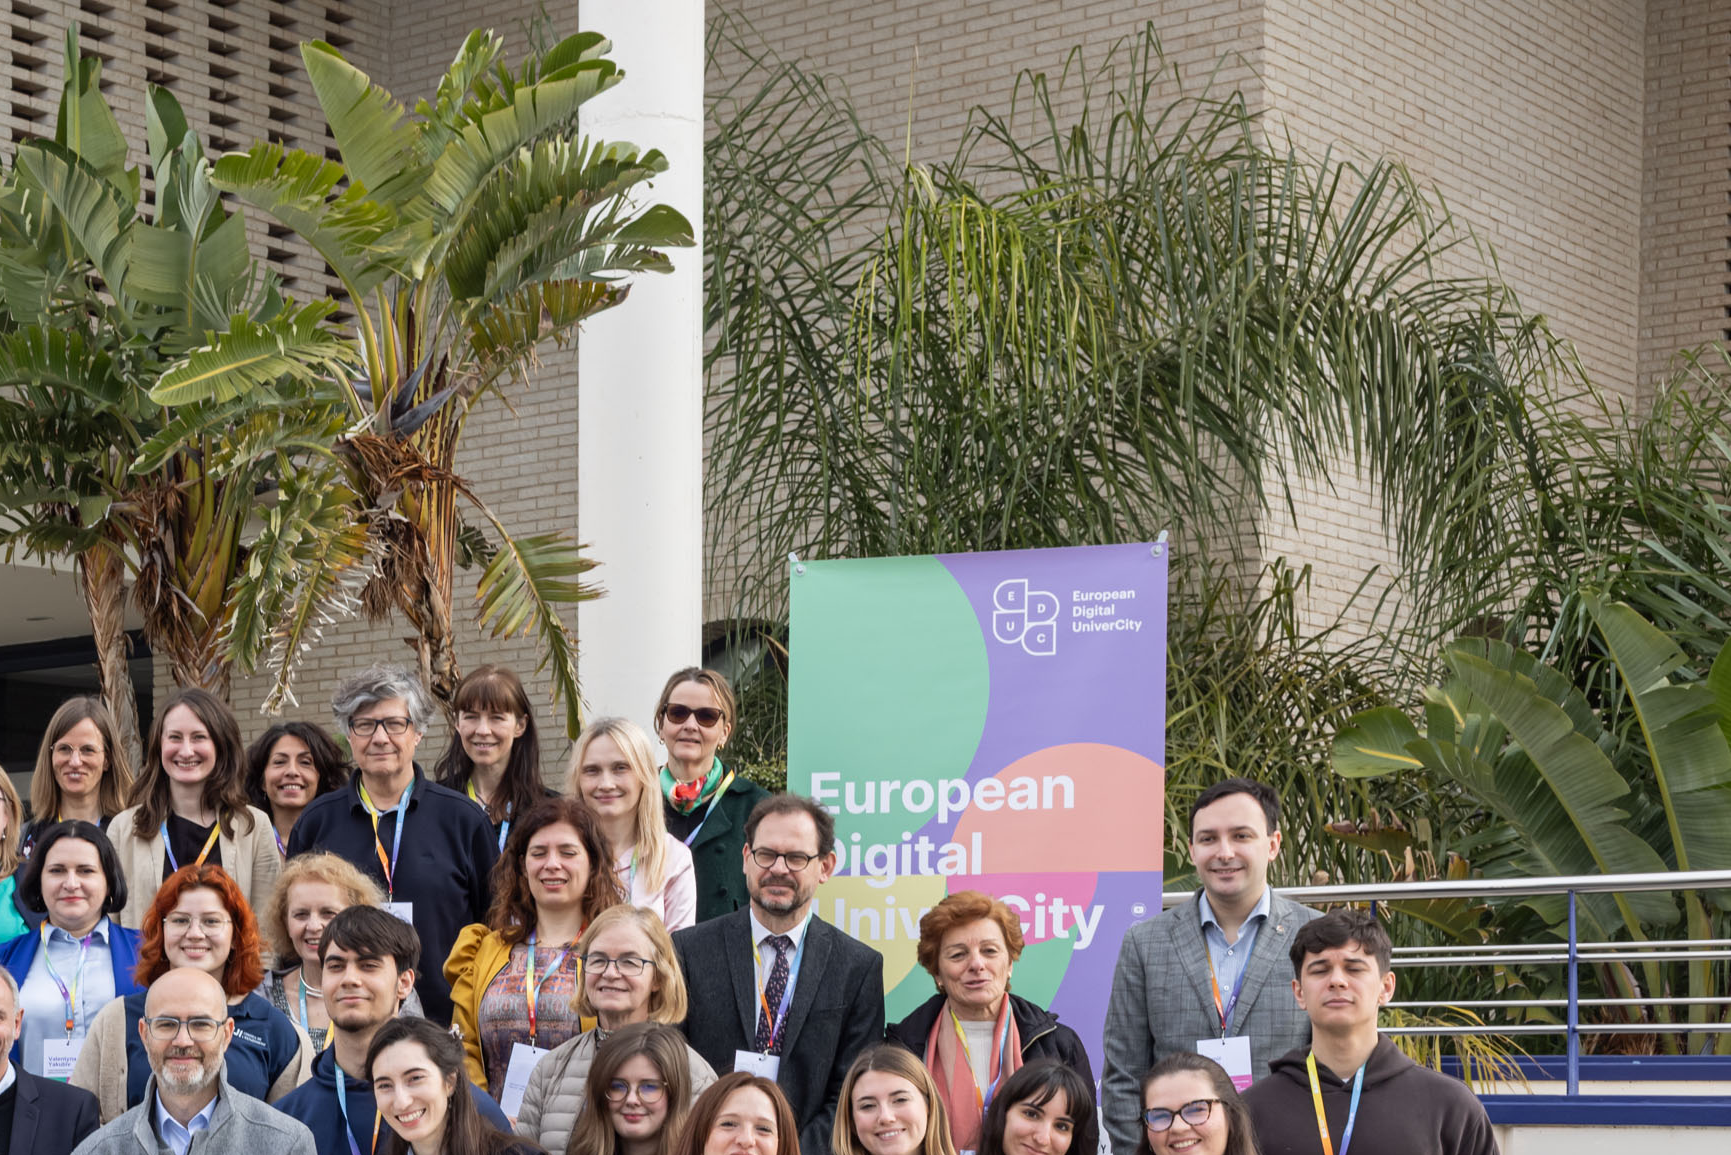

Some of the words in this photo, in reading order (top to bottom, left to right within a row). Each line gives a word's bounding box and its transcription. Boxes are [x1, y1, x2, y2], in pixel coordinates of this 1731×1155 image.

[1072, 590, 1135, 602] European
[1072, 604, 1115, 619] Digital
[1072, 619, 1142, 632] UniverCity
[811, 771, 1075, 824] European
[813, 892, 1105, 950] UnivCity
